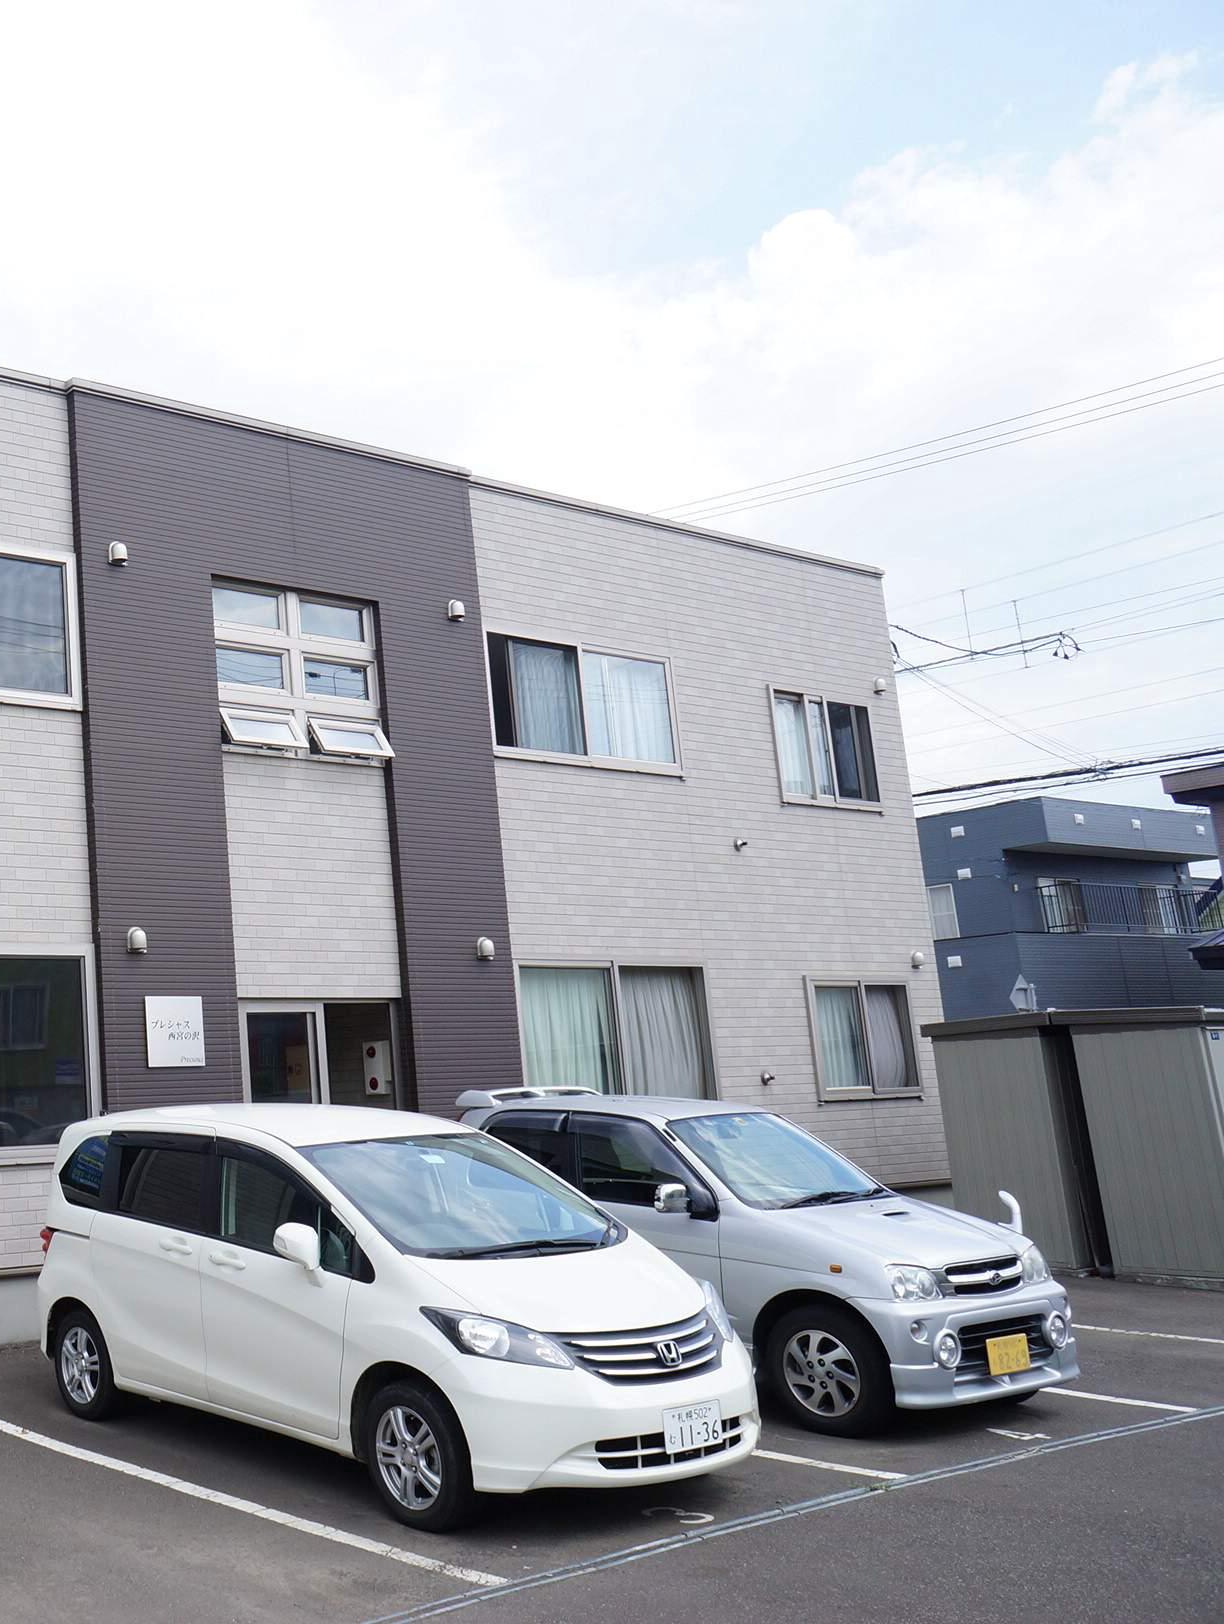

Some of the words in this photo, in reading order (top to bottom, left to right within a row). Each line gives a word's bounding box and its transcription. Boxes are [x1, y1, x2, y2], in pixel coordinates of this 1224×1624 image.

[152, 1020, 190, 1029] プレシャス
[680, 1419, 719, 1447] 11-36
